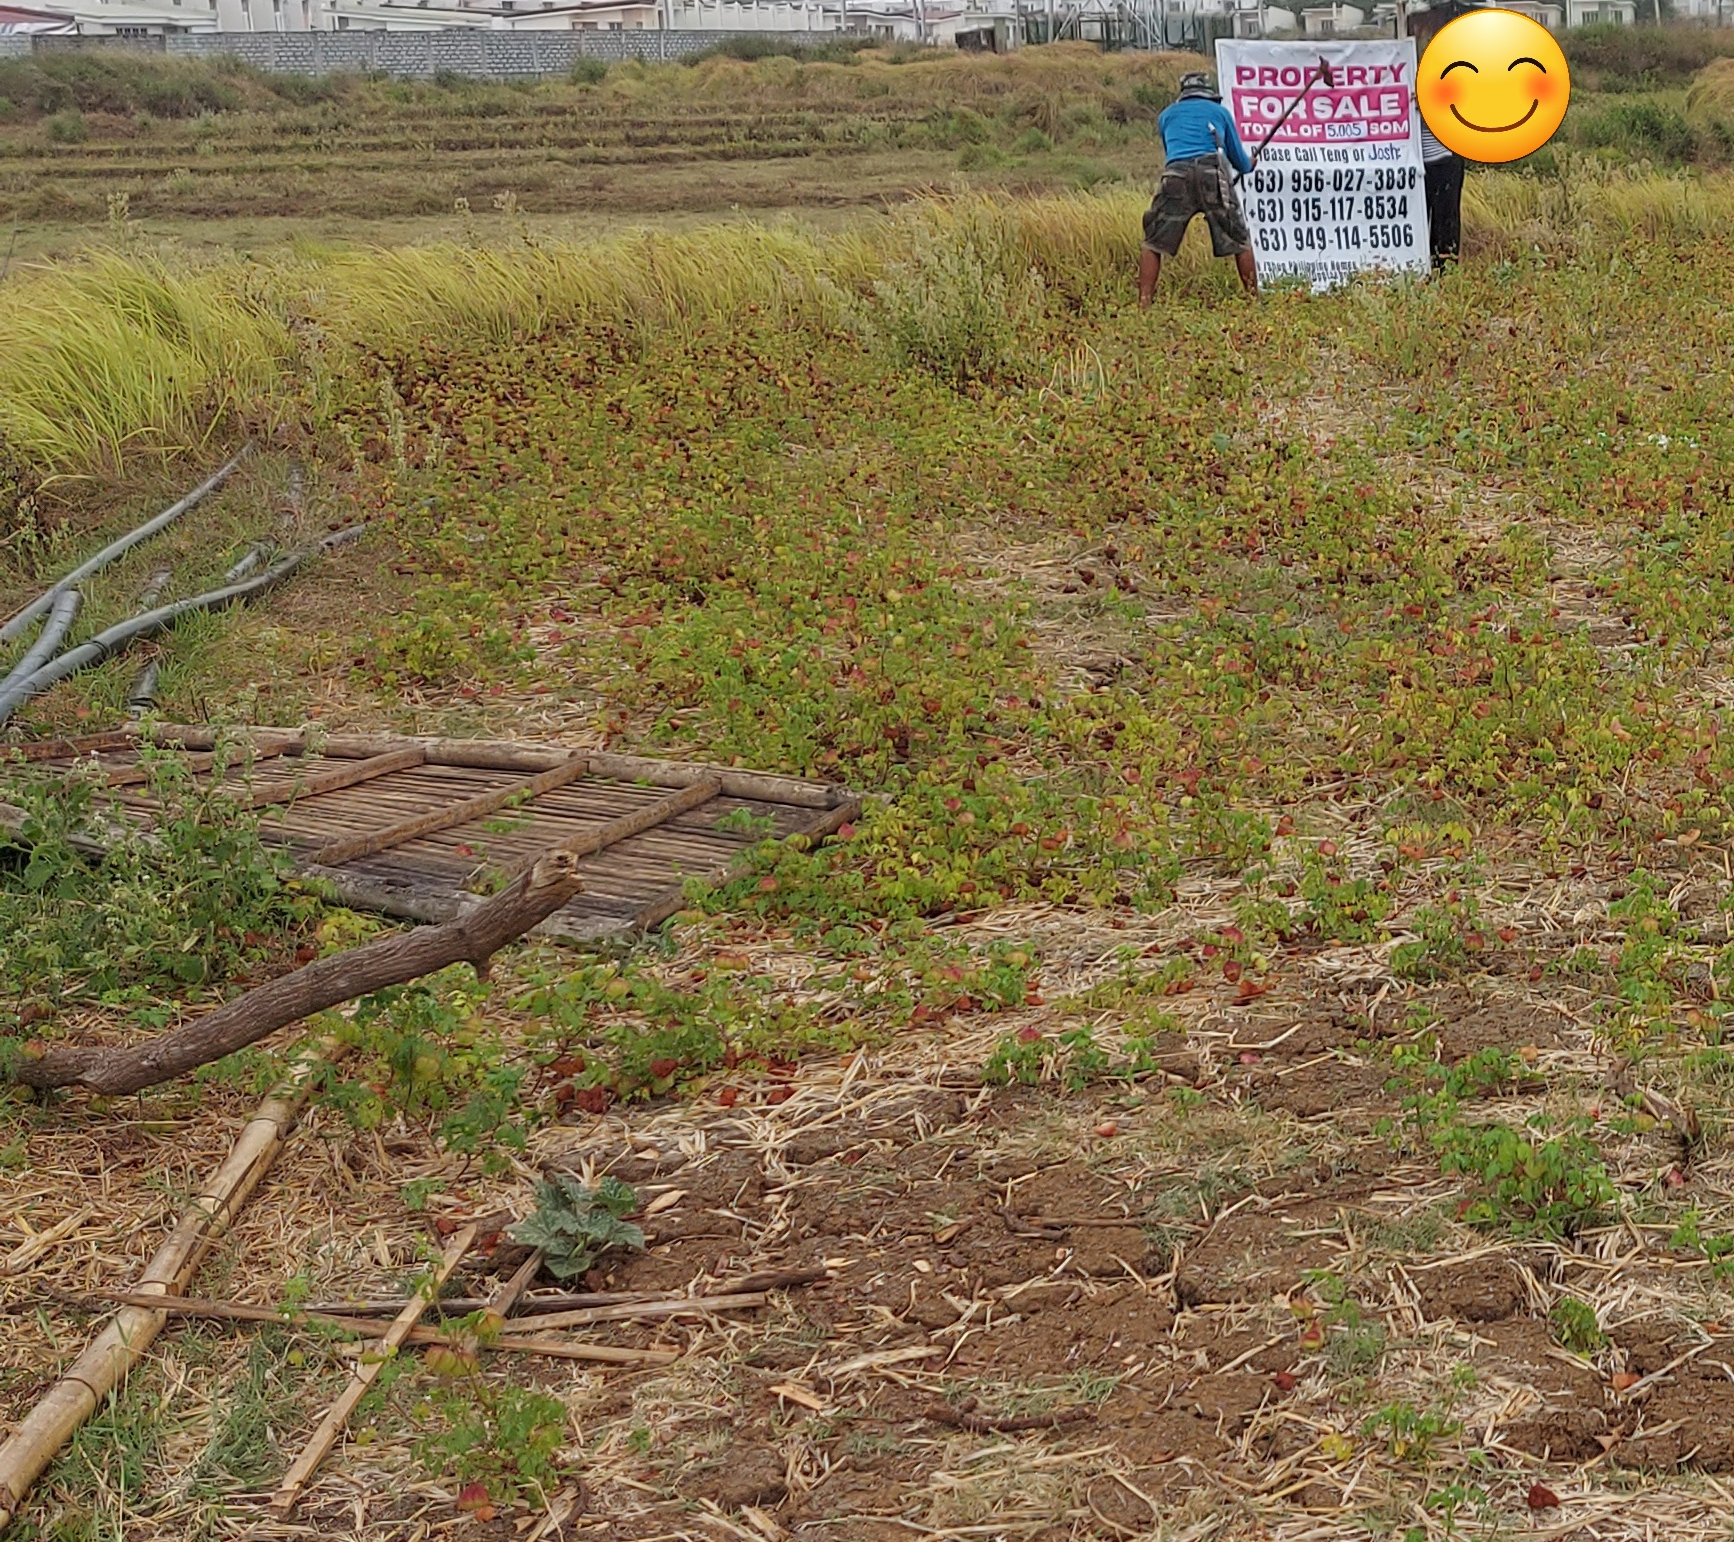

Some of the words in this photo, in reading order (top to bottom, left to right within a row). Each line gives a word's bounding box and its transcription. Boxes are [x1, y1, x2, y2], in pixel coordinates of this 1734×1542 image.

[1235, 63, 1406, 86] PROPERTY
[1241, 95, 1307, 119] FOR
[1312, 93, 1401, 119] SALE
[1240, 122, 1297, 137] TOTAL
[1299, 124, 1322, 137] OF
[1251, 146, 1291, 162] Please
[1295, 147, 1318, 162] Call
[1320, 147, 1349, 163] Teng
[1352, 148, 1365, 161] or
[1240, 169, 1284, 193] (+63)
[1242, 198, 1284, 223] (+63)
[1291, 195, 1408, 222] 915-117-8534
[1294, 223, 1414, 251] 949-114-5506
